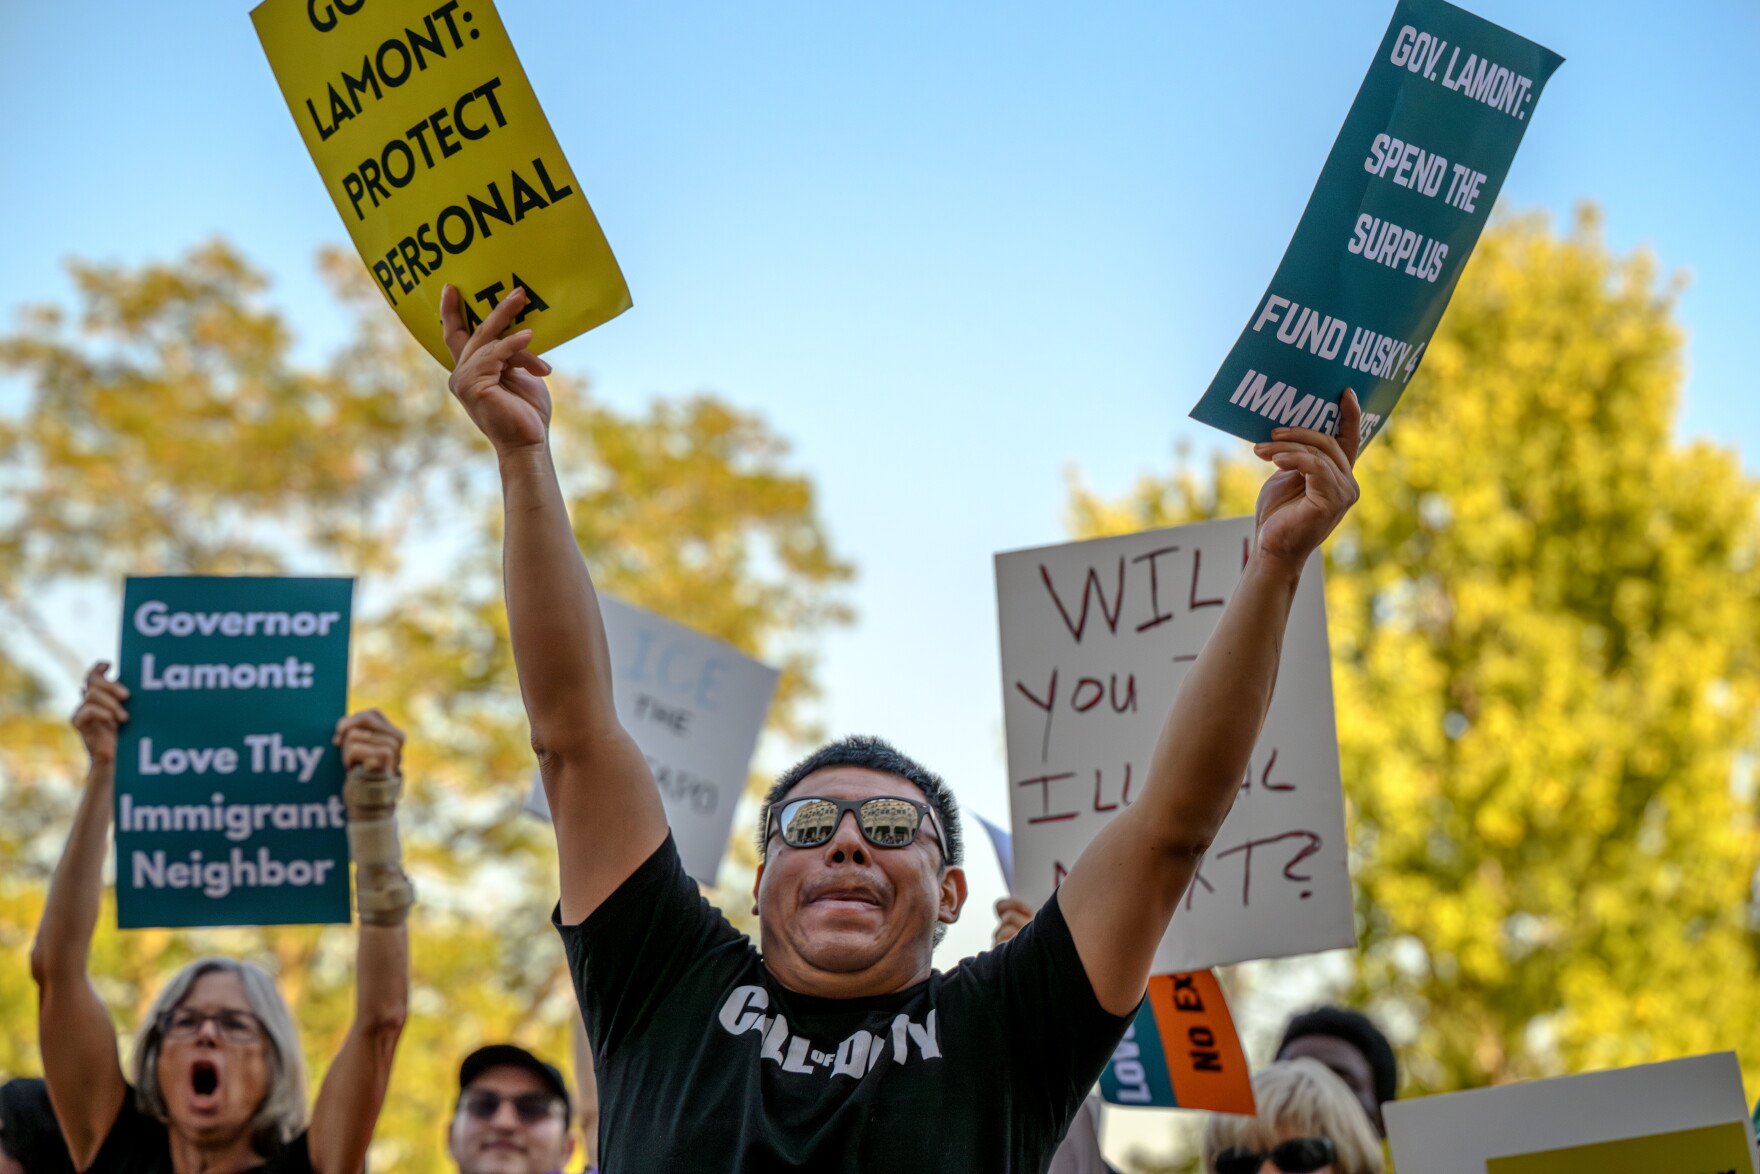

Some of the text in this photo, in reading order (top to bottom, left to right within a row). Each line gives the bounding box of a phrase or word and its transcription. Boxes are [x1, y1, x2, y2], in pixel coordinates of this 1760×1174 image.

[306, 0, 480, 141] LAMONT:
[1390, 25, 1532, 120] GOV. LAMONT:
[342, 77, 508, 221] PROTECT
[1364, 133, 1487, 213] SPEND THE
[373, 158, 573, 306] PERSONAL
[1348, 213, 1449, 283] SURPLUS
[1253, 294, 1425, 383] FUND HUSKY 4
[133, 601, 340, 637] Governor
[140, 653, 315, 690] Lamont:
[623, 628, 728, 711] ICE
[1016, 668, 1137, 763] YOU
[139, 733, 323, 783] Love Thy
[119, 793, 346, 841] Immigrant
[132, 847, 335, 899] Neighbor
[810, 1048, 835, 1067] OF
[1188, 1026, 1223, 1072] NO
